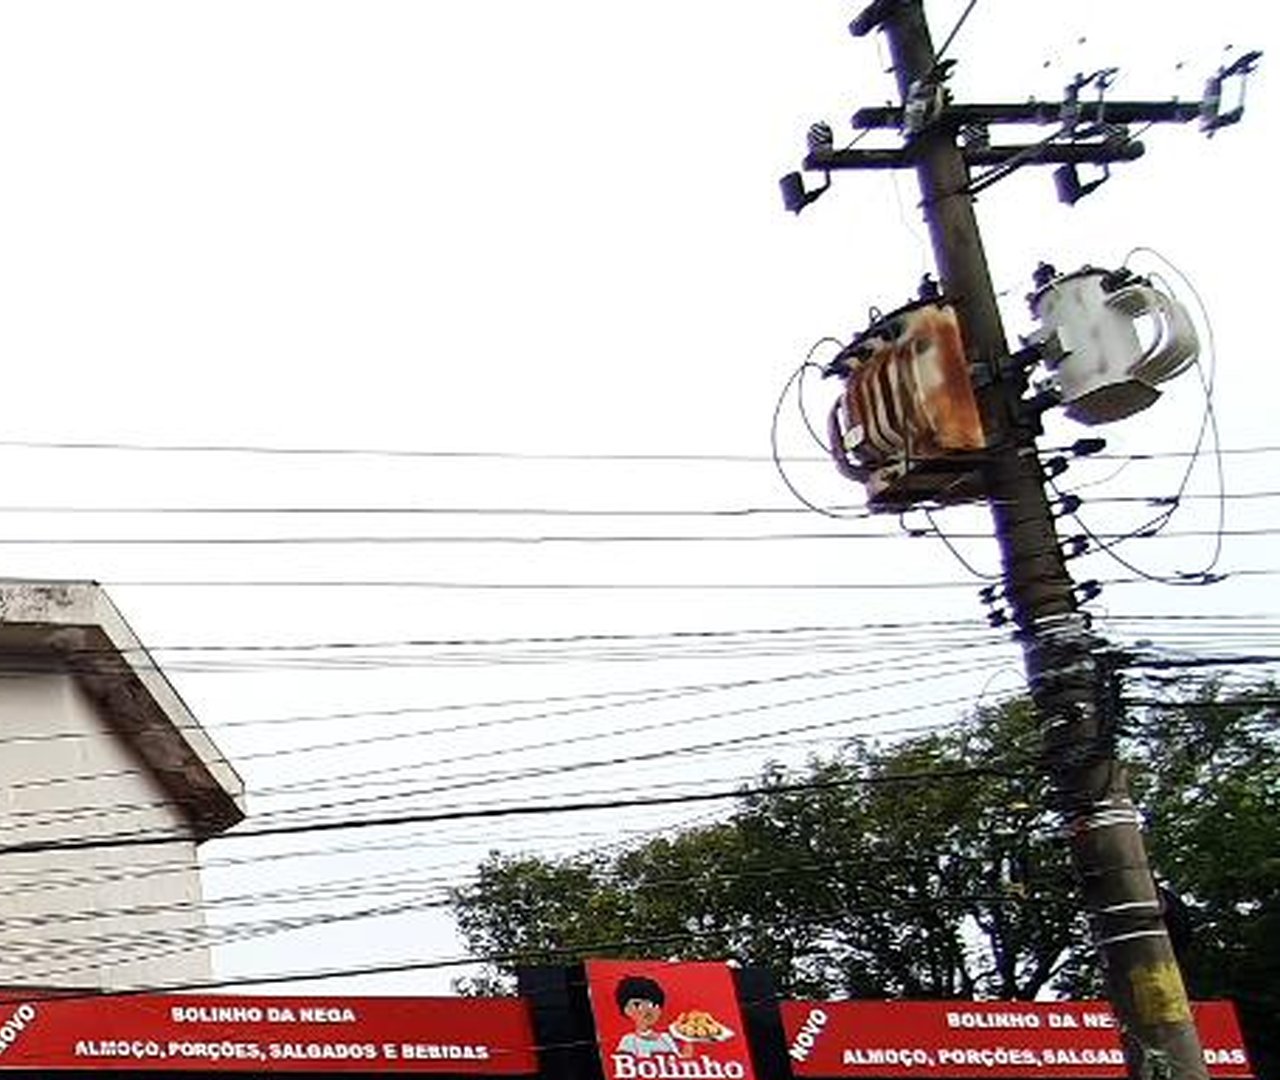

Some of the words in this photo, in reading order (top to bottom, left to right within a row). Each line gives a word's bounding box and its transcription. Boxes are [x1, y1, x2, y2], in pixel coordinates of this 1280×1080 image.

[171, 1007, 262, 1023] BOLINHO
[267, 1007, 296, 1023] DA
[300, 1007, 356, 1023] NEGA
[946, 1012, 1040, 1029] BOLINHO
[1048, 1013, 1078, 1029] DA
[1083, 1013, 1116, 1030] NE
[790, 1008, 828, 1062] NOVO
[269, 1043, 377, 1060] SALGADOS
[382, 1044, 397, 1060] E
[401, 1045, 489, 1061] BEBIDAS
[1043, 1049, 1125, 1066] SALGAD
[610, 1053, 744, 1079] Bolinho
